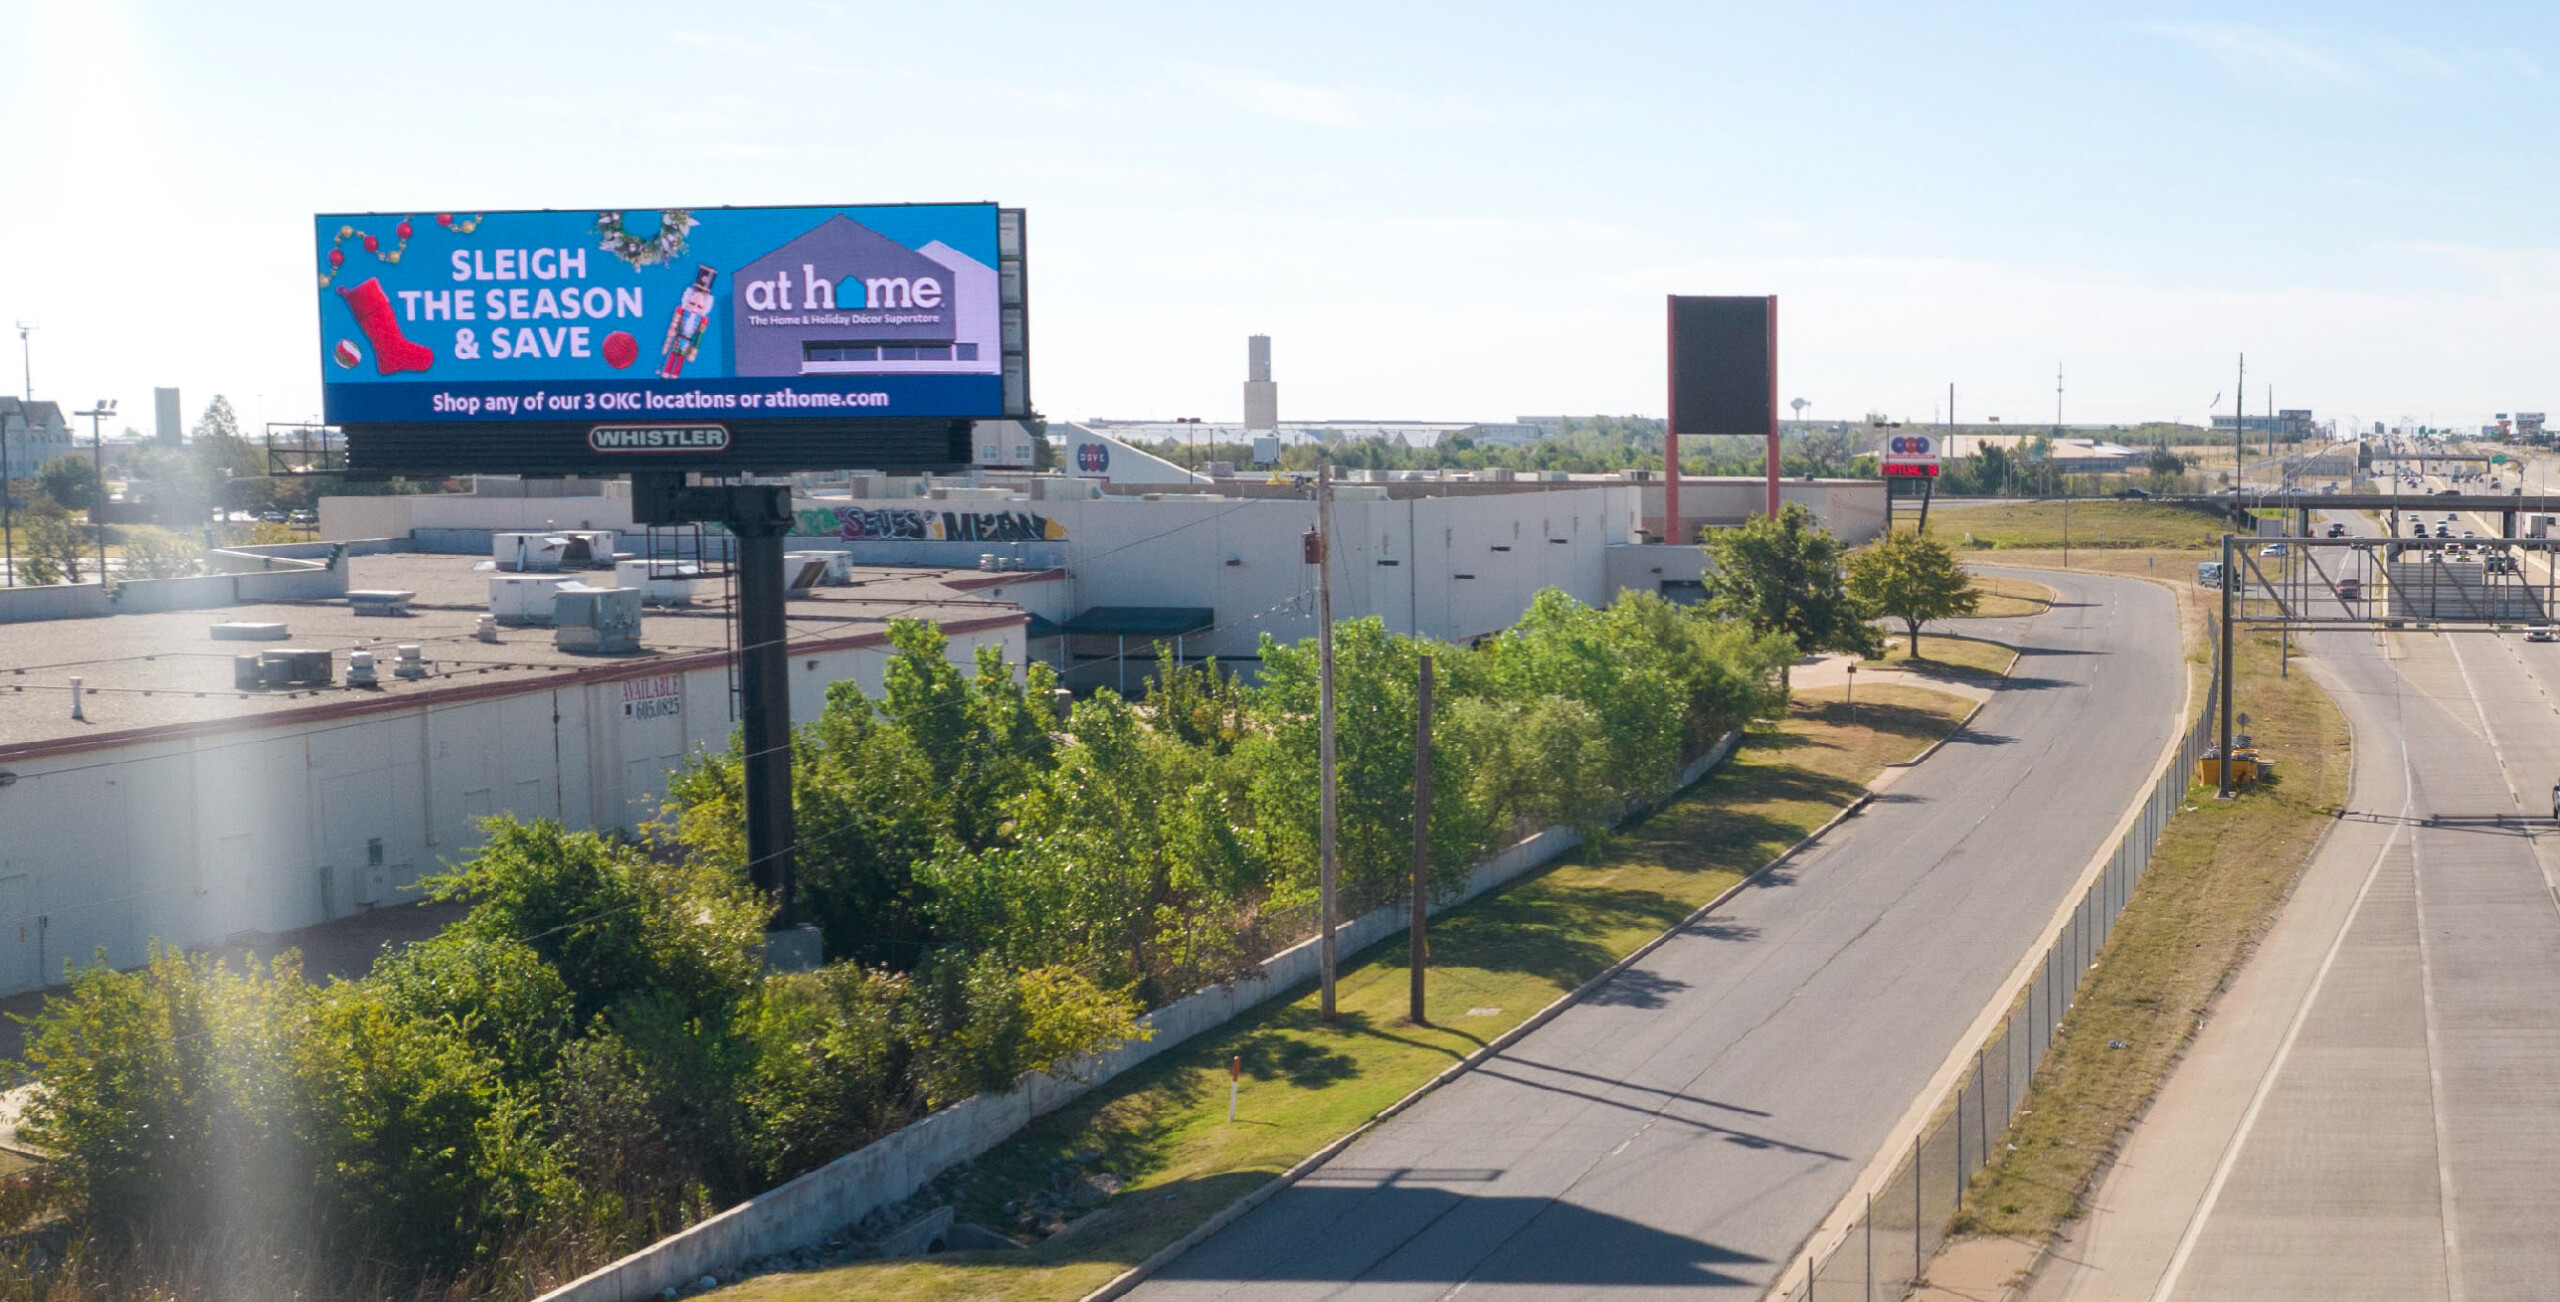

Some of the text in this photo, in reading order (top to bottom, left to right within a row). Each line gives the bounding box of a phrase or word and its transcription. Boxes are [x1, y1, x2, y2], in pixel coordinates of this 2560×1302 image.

[451, 247, 587, 282] SLEIGH
[397, 286, 644, 321] THE SEASON
[745, 271, 793, 311] at
[749, 311, 940, 326] The Home & Holiday Décor Superstore
[454, 326, 591, 360] & SAVE
[433, 388, 889, 415] Shop any of our 3 OKC locations or athome.com
[596, 430, 723, 446] WHISTLER
[623, 677, 679, 700] AVAILABLE
